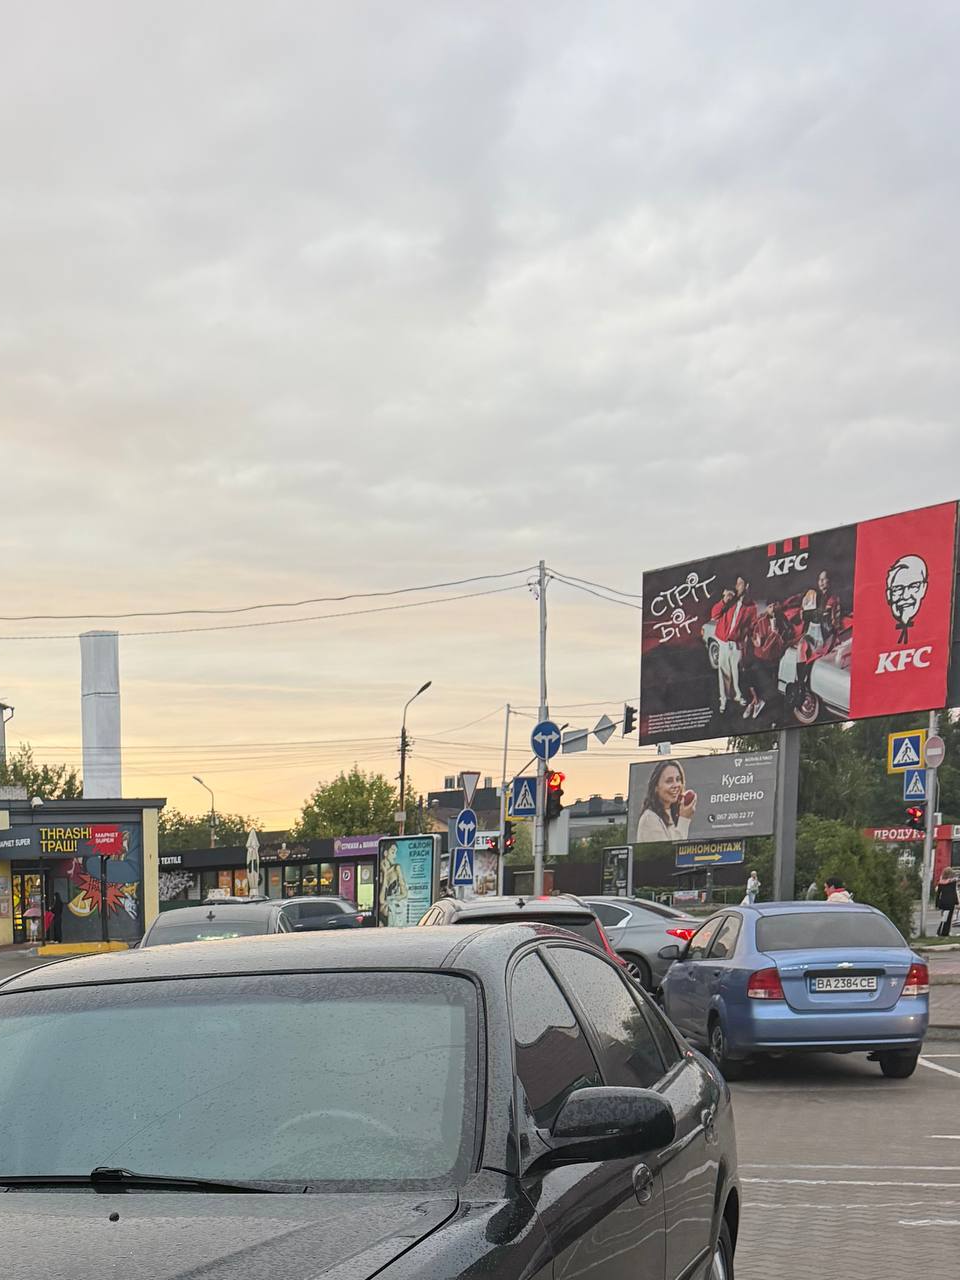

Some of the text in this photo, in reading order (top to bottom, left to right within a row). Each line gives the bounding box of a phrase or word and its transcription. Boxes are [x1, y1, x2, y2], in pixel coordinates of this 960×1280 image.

[766, 553, 809, 578] KFC
[874, 646, 933, 674] KFC
[721, 772, 754, 788] Кусай
[710, 790, 764, 804] впевнено
[39, 827, 92, 840] THRASH!
[873, 827, 938, 840] ПРОДУК
[39, 840, 78, 852] ТРАШ!
[408, 842, 431, 850] САЛОН
[678, 842, 741, 856] ШИНОМОНТАЖ
[817, 977, 875, 989] BA 2384 CE
